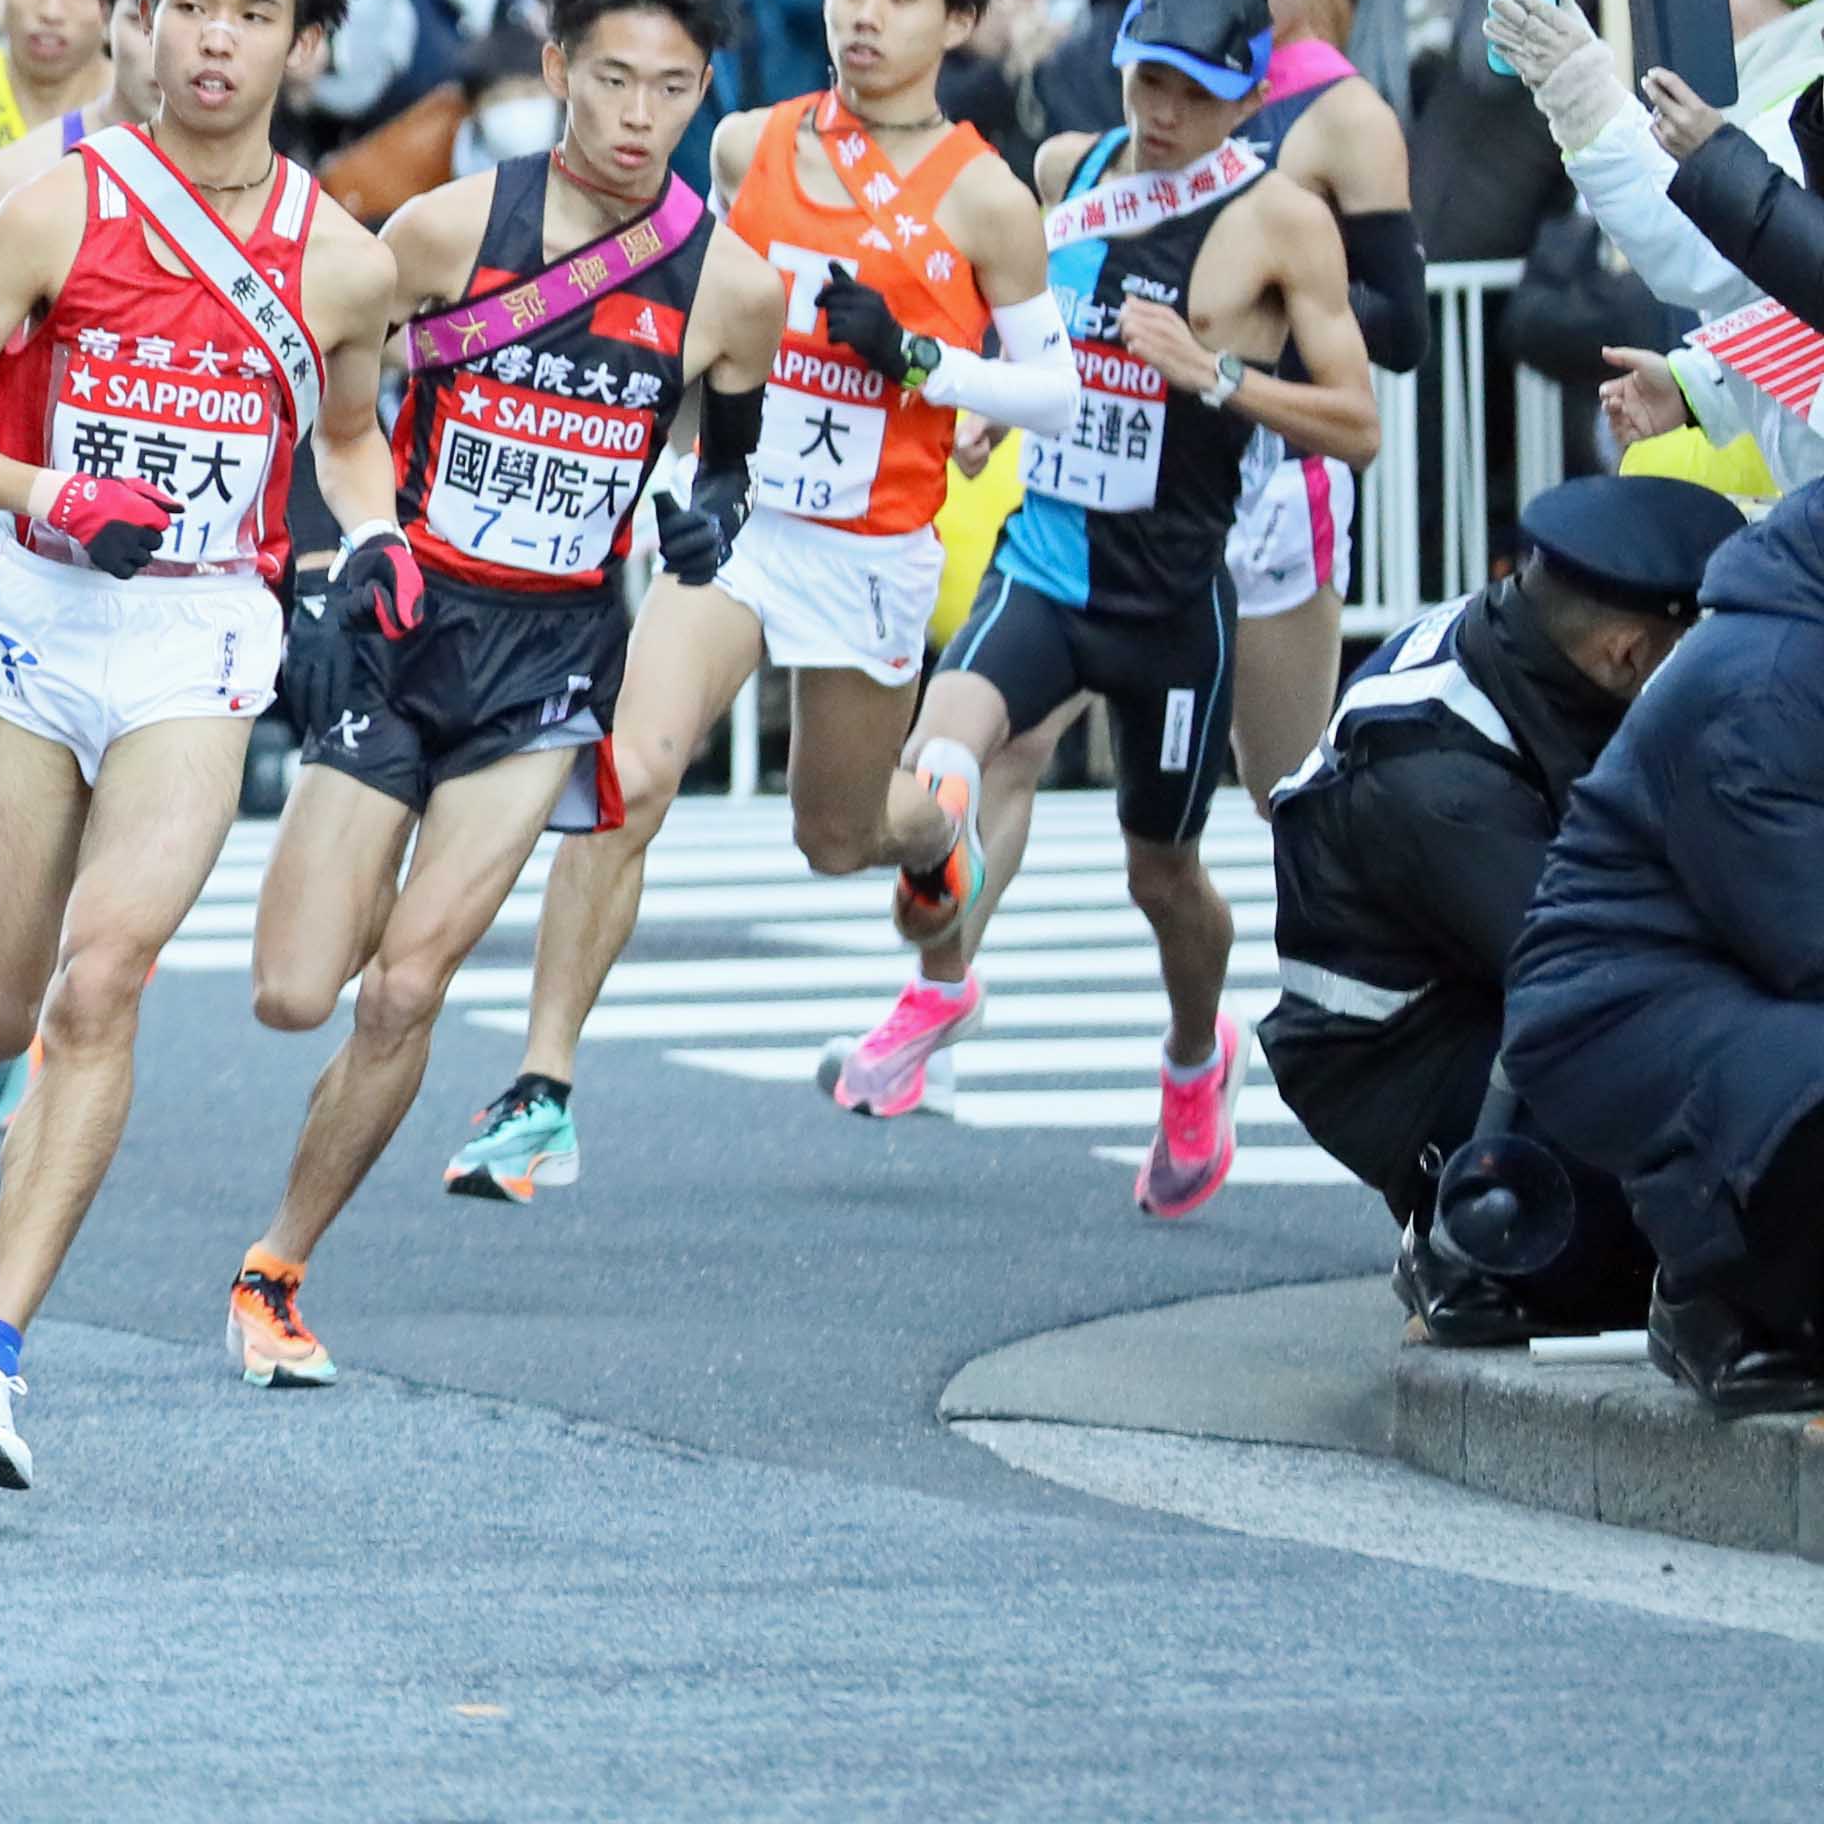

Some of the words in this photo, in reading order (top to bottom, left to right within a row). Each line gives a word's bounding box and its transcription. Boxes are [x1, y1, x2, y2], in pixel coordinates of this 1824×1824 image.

[105, 374, 263, 426] SAPPORO
[465, 344, 662, 410] 學院大學
[495, 398, 646, 452] SAPPORO
[1071, 393, 1153, 463] 生連合
[72, 421, 241, 505] 帝京大
[445, 430, 631, 522] 國學院大
[763, 474, 833, 513] -13
[1027, 446, 1107, 504] 21-1
[471, 504, 583, 566] 7-15
